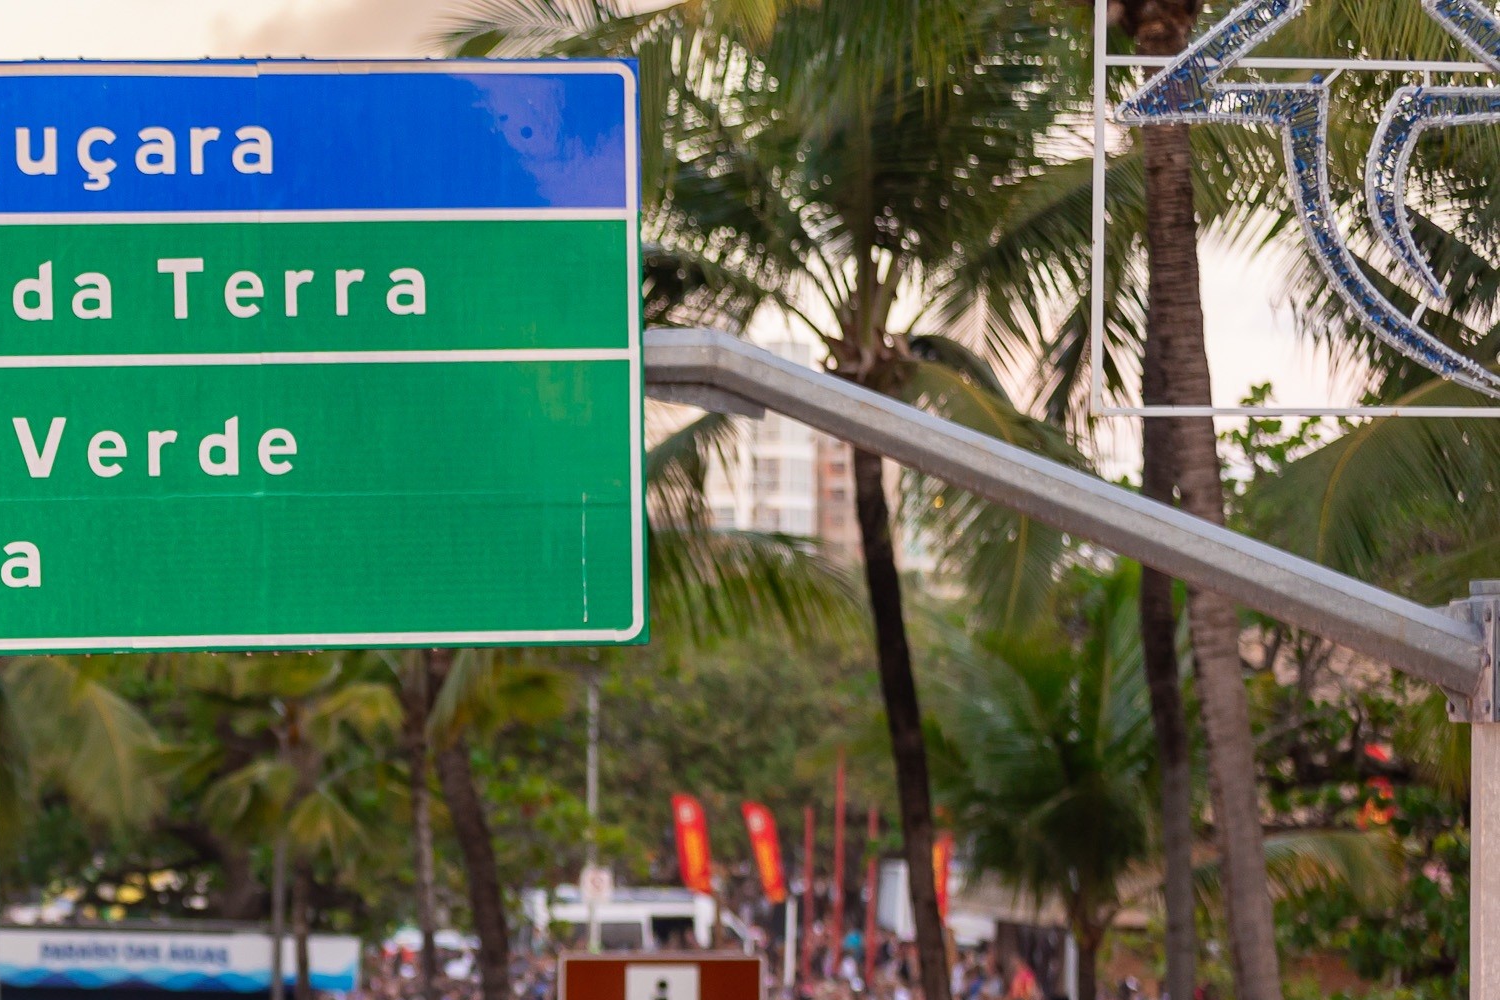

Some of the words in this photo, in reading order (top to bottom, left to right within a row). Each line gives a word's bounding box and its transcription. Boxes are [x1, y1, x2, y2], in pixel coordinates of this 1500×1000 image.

[11, 260, 113, 321] da
[156, 257, 427, 319] Terra
[11, 416, 299, 478] Verde
